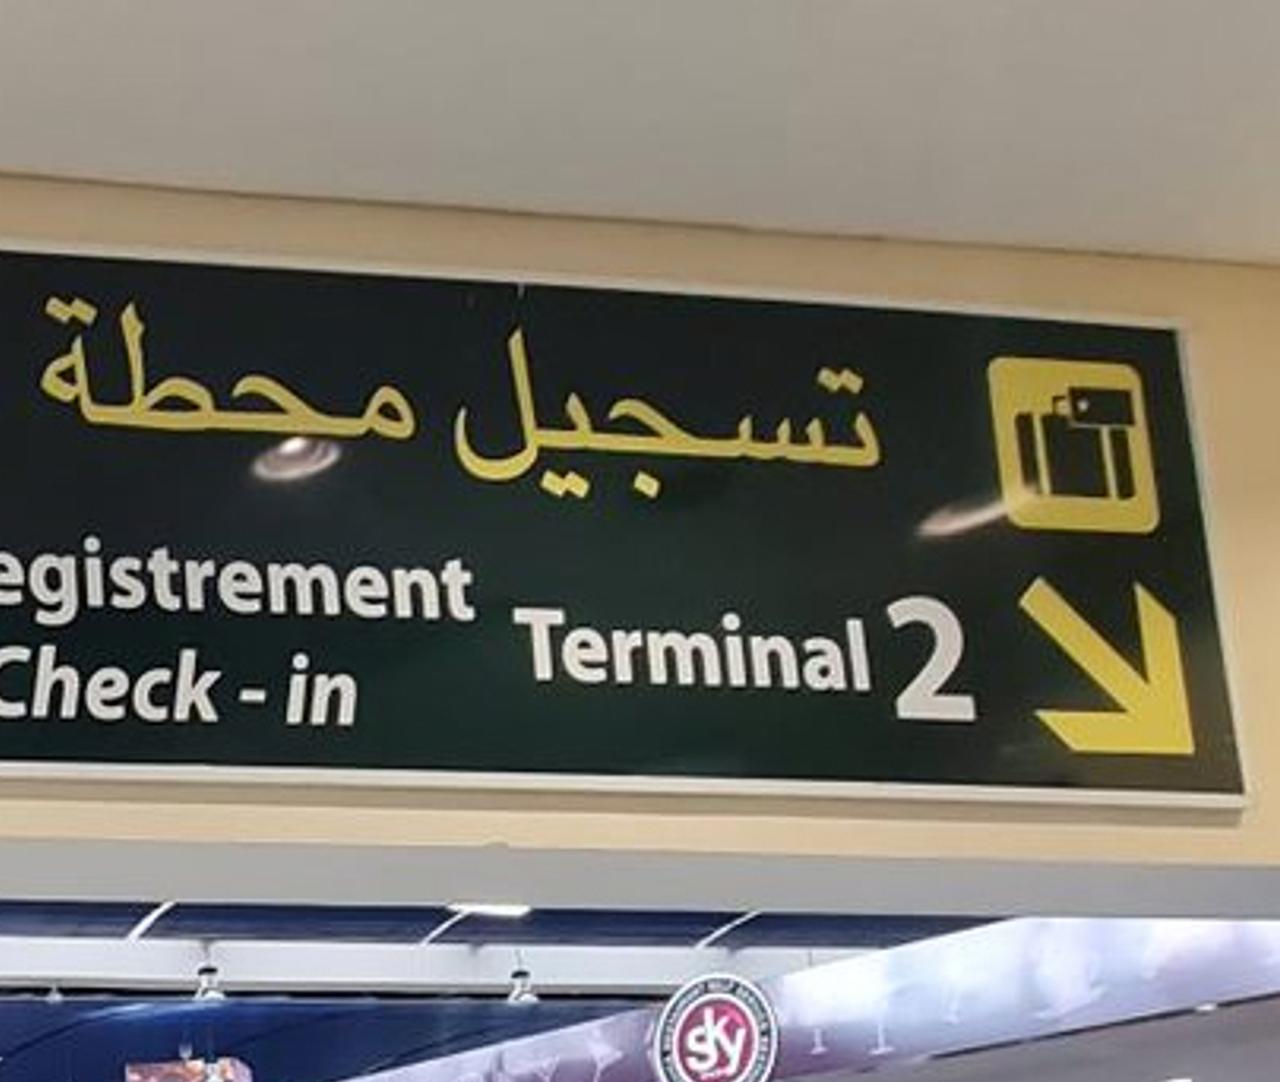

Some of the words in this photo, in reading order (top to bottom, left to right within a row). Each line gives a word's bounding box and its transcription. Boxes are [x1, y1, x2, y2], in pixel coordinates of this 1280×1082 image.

[40, 296, 418, 441] محطة
[453, 326, 881, 499] تسجيل
[284, 653, 359, 726] in
[512, 606, 872, 692] Terminal
[886, 596, 978, 722] 2
